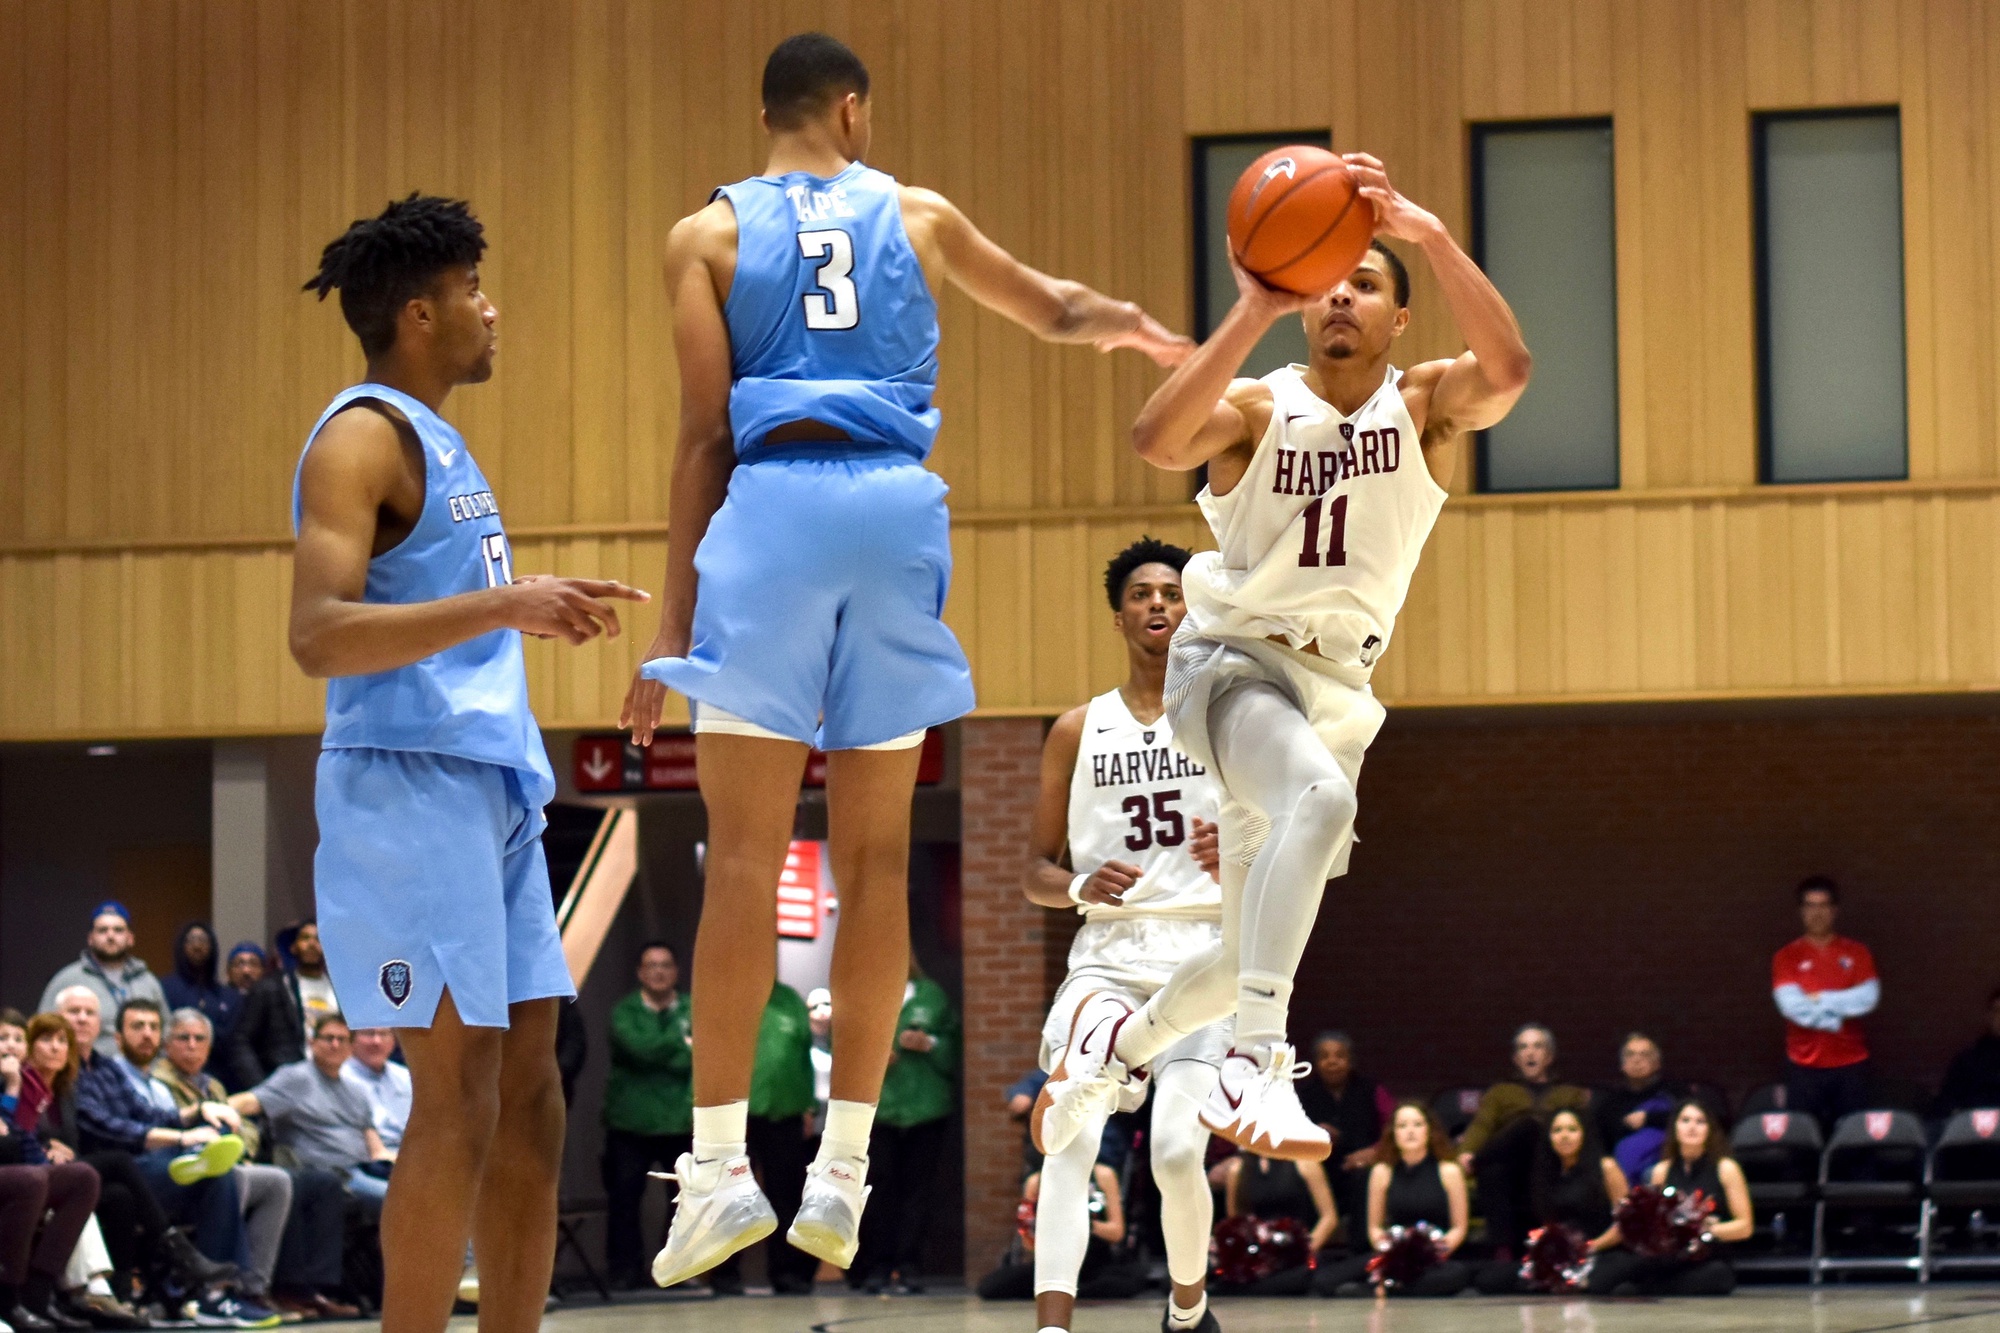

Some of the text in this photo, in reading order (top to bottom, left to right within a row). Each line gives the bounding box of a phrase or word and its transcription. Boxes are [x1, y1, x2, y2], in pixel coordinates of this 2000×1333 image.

[797, 228, 860, 331] 3
[1298, 494, 1348, 567] 11
[1122, 789, 1185, 852] 35
